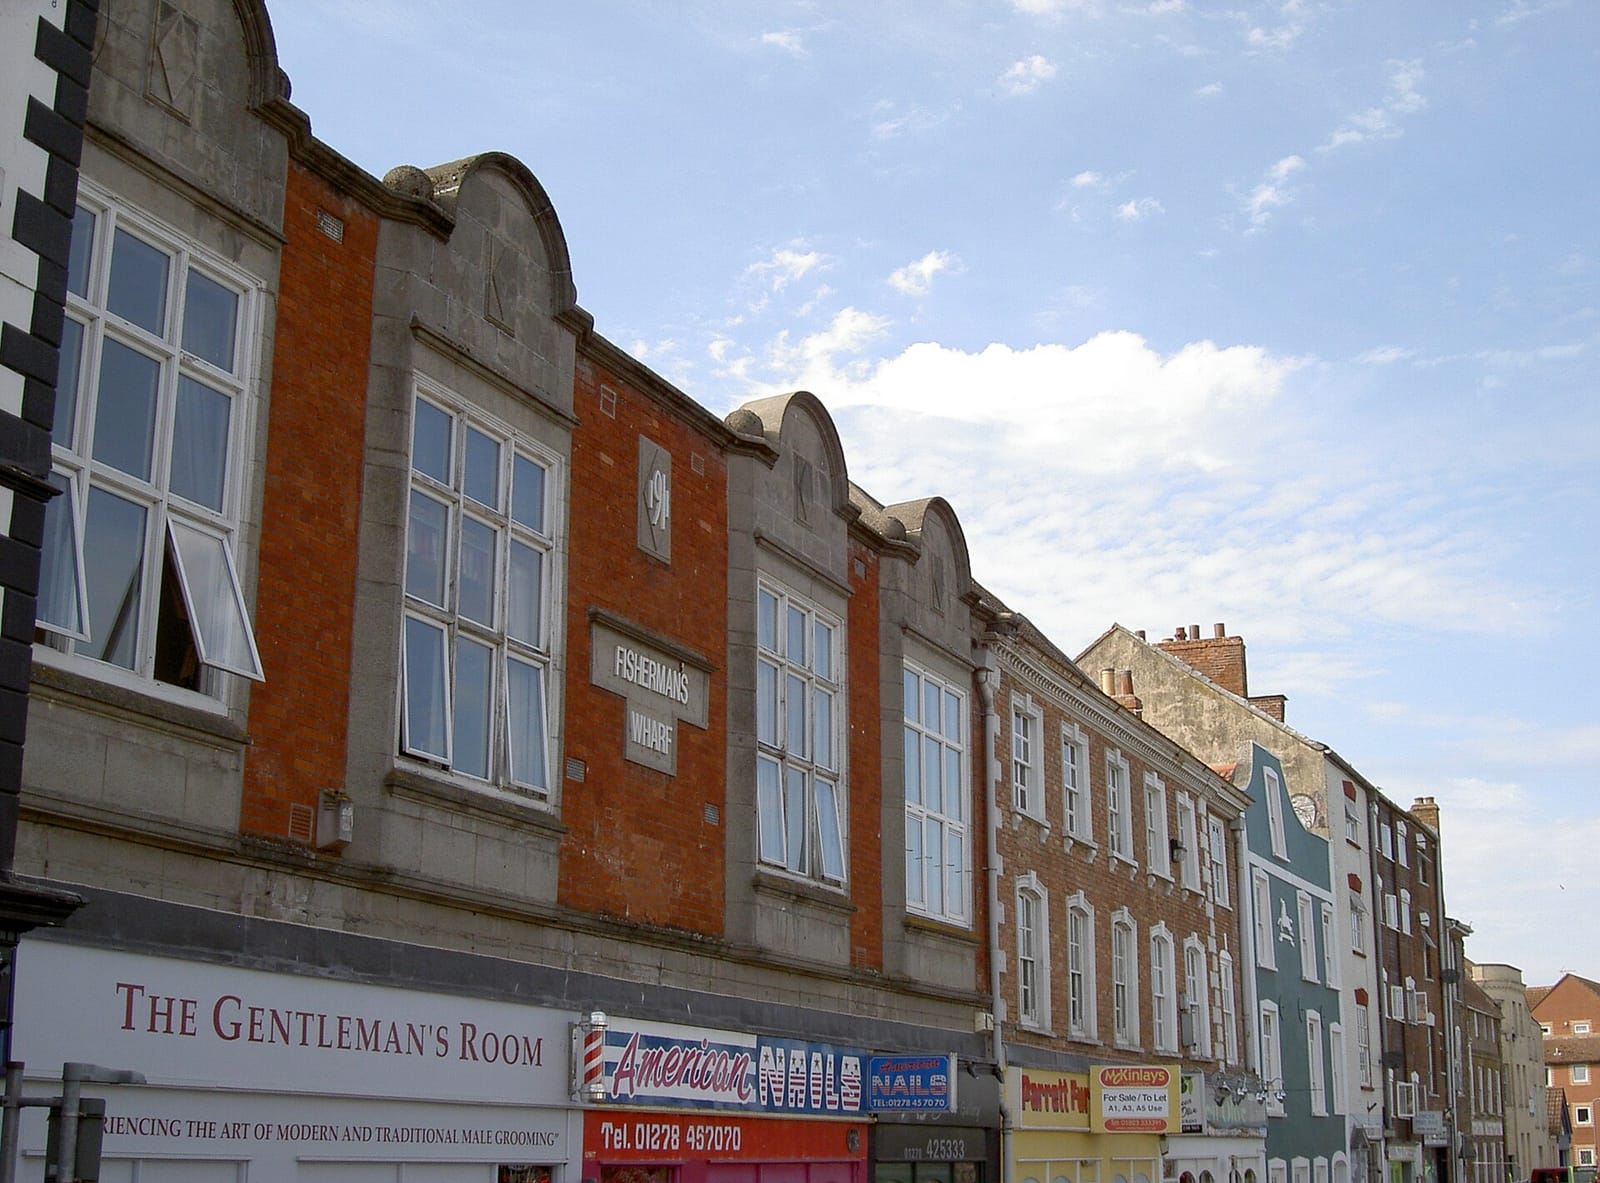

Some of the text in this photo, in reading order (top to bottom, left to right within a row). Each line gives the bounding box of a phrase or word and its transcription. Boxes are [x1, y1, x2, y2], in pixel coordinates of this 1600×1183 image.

[648, 470, 670, 530] 1911
[615, 645, 689, 705] FISHERMAN'S
[631, 711, 673, 754] WHARF
[116, 982, 543, 1067] THE GENTLEMAN'S ROOM
[611, 1030, 862, 1112] American NAILS
[872, 1074, 947, 1096] NAILS
[1103, 1093, 1118, 1102] For
[1119, 1093, 1137, 1103] Sale
[1142, 1093, 1153, 1102] To
[1154, 1093, 1167, 1102] Let
[186, 1120, 217, 1140] THE
[220, 1121, 251, 1140] ART
[254, 1123, 274, 1141] OF
[276, 1123, 340, 1142] MODERN
[341, 1125, 373, 1143] AND
[375, 1126, 460, 1145] TRADITIONAL
[461, 1129, 493, 1145] MALE
[601, 1121, 741, 1152] Tel. 01278 457070
[926, 1138, 965, 1160] 425333
